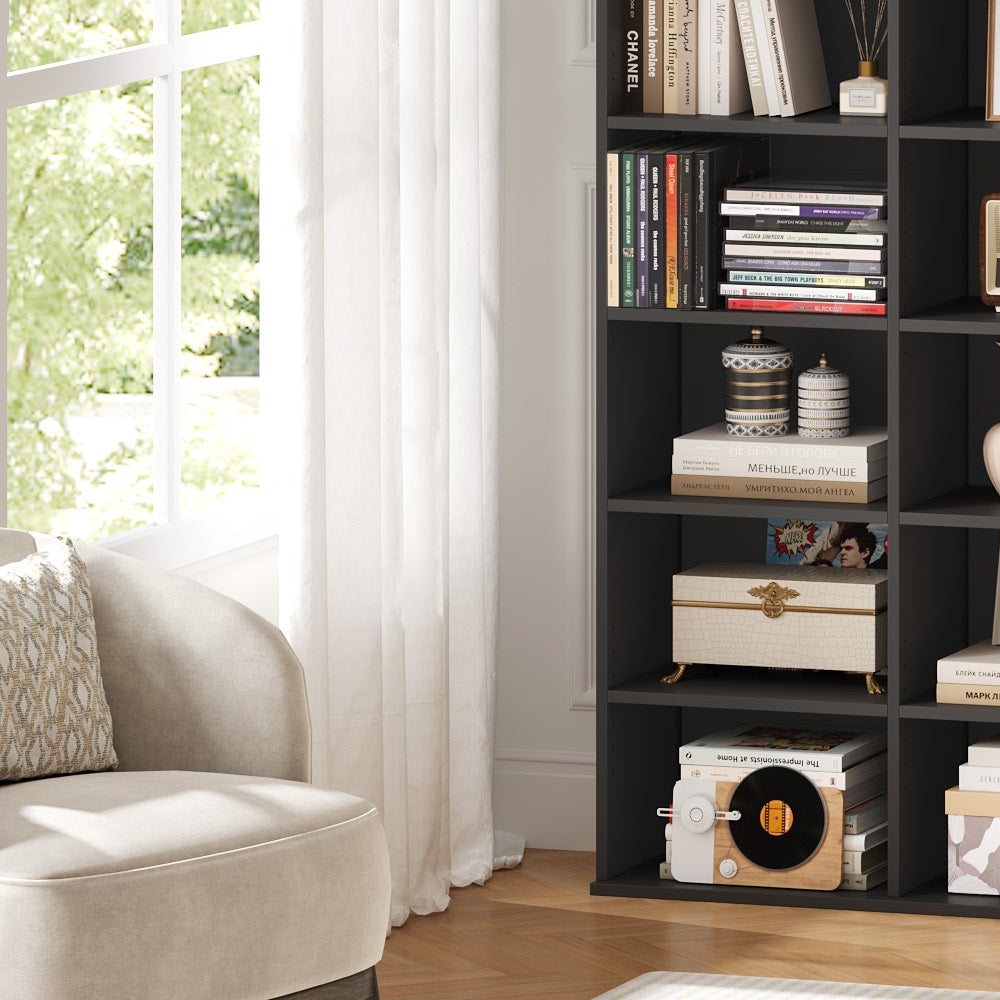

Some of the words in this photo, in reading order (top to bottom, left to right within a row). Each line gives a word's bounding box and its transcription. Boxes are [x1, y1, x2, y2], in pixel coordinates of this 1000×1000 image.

[648, 0, 659, 37] amanda
[714, 3, 726, 45] McCartney
[736, 1, 753, 44] СПАСИТЕ
[745, 46, 761, 88] КОТИКА!
[627, 30, 639, 93] CHANEL
[648, 39, 659, 77] lovelace
[666, 33, 677, 88] Huffington
[668, 163, 676, 178] Steel
[817, 466, 857, 477] ЛУЧШЕ
[965, 691, 991, 700] МАРК
[716, 754, 738, 763] Home
[740, 755, 748, 763] at
[750, 756, 804, 767] Impressionists
[806, 759, 820, 768] The
